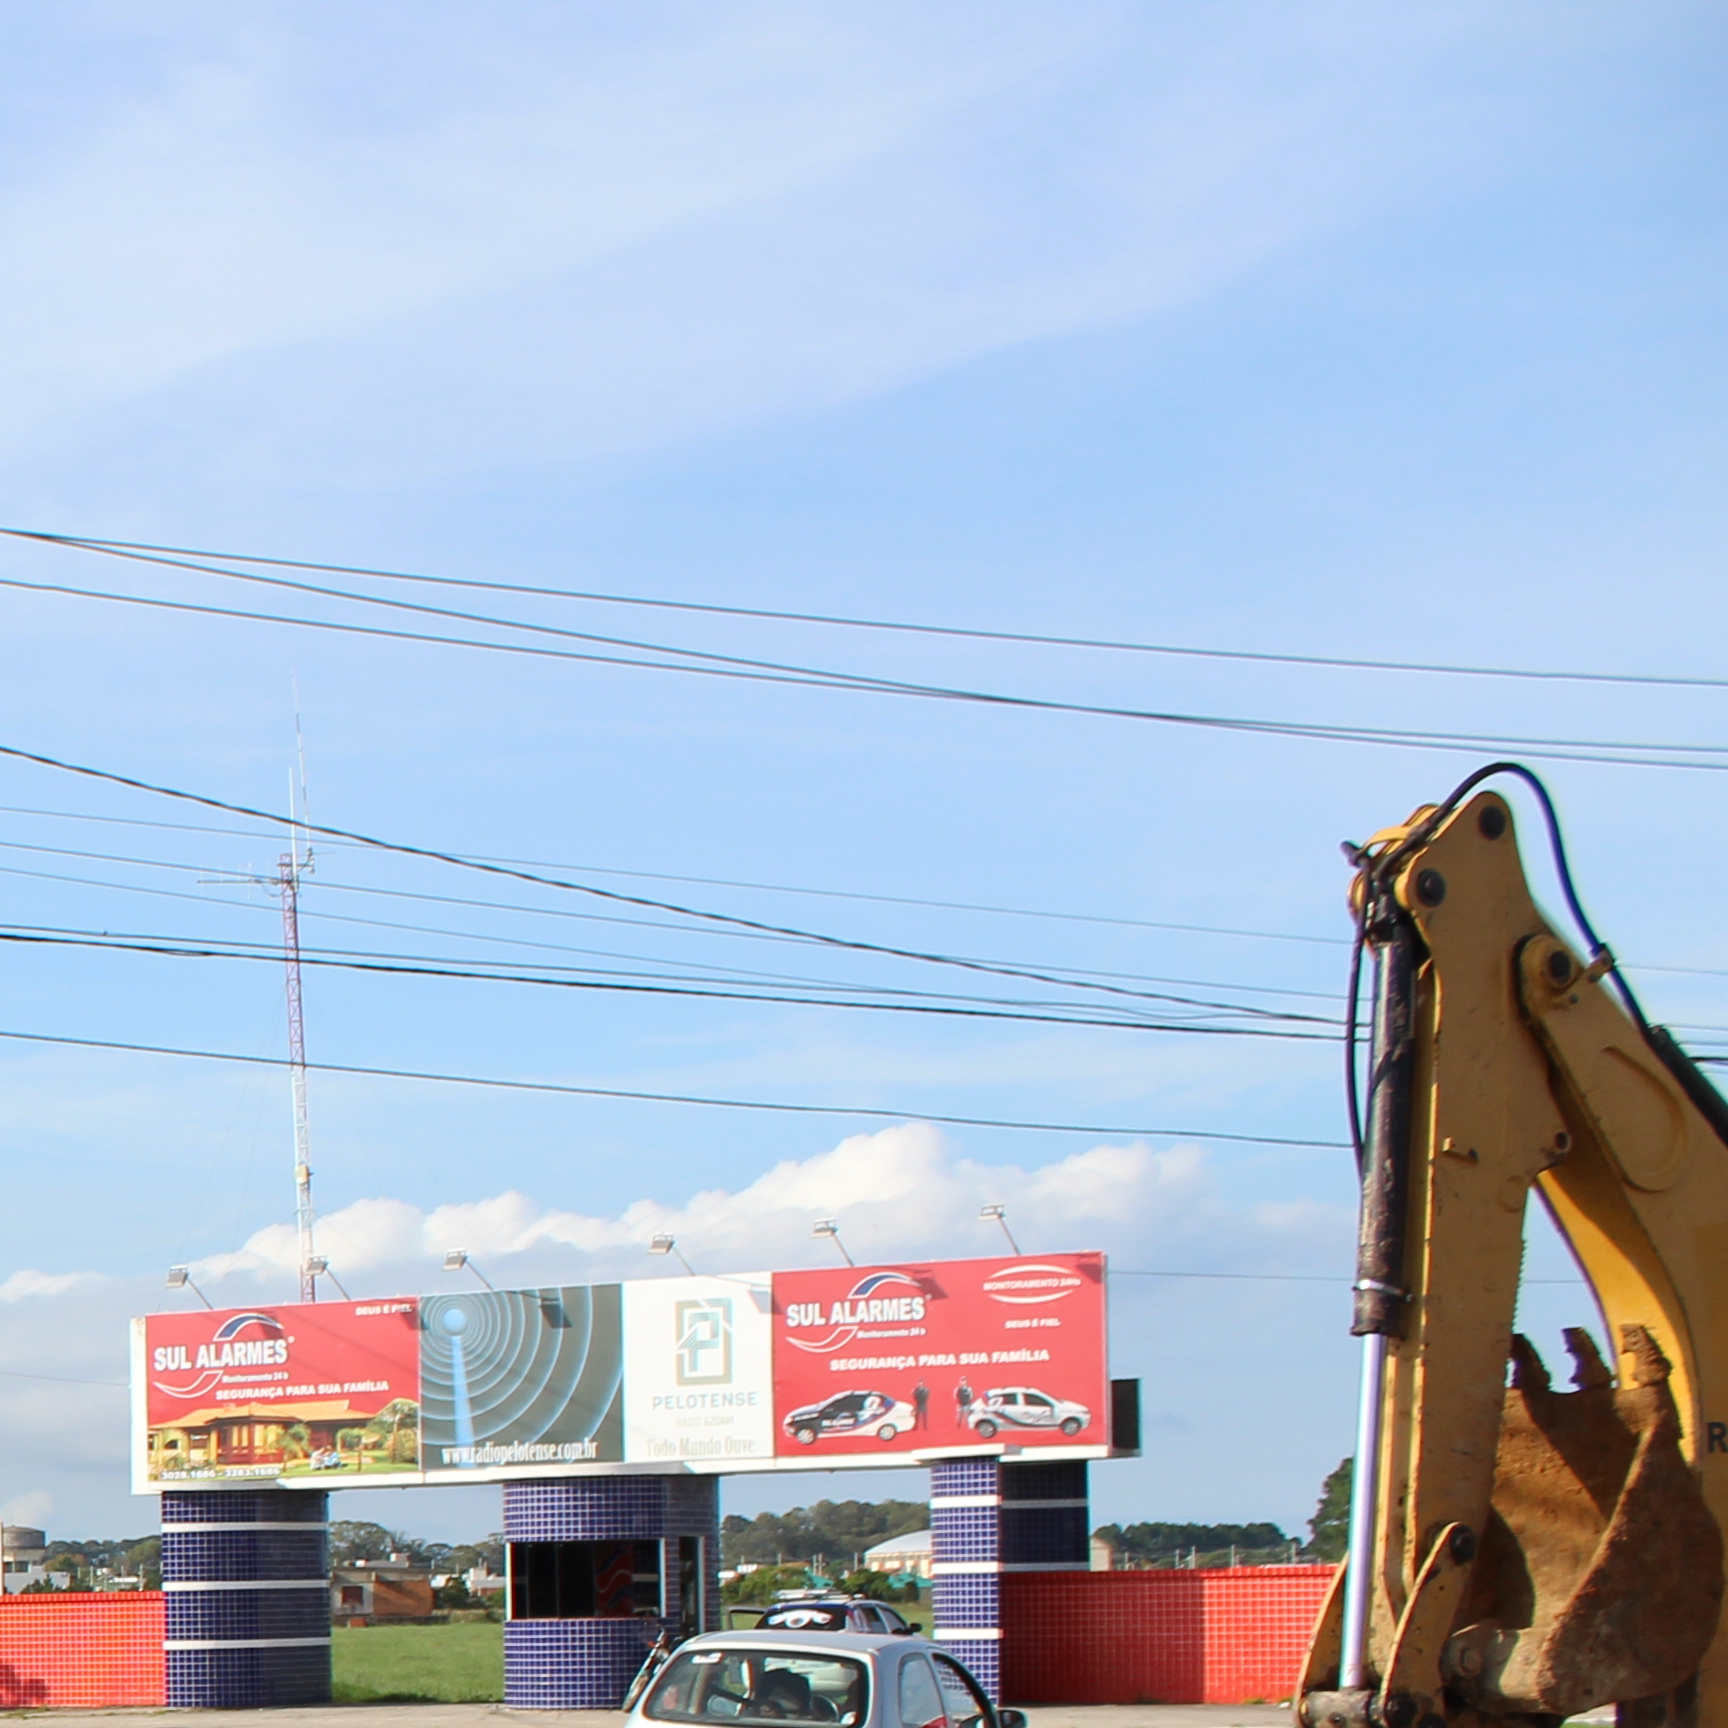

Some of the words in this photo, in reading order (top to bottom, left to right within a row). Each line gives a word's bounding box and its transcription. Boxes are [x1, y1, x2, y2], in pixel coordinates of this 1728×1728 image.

[355, 1305, 381, 1316] DEUS
[786, 1302, 825, 1327] SUL
[830, 1297, 925, 1324] ALARMES
[153, 1345, 191, 1371] SUL
[195, 1339, 288, 1369] ALARMES
[829, 1356, 915, 1371] SEGURANÇA
[918, 1353, 956, 1367] PARA
[960, 1351, 989, 1365] SUA
[991, 1347, 1050, 1363] FAMÍLIA
[215, 1386, 284, 1400] SEGURANÇA
[286, 1382, 316, 1396] PARA
[318, 1382, 341, 1395] SUA
[343, 1379, 389, 1393] FAMÍLIA
[652, 1391, 758, 1411] PELOTENSE
[441, 1437, 599, 1465] www.radiopelotense.com.br
[646, 1438, 677, 1457] Todo
[679, 1436, 722, 1456] Mundo
[725, 1435, 756, 1455] Ouve
